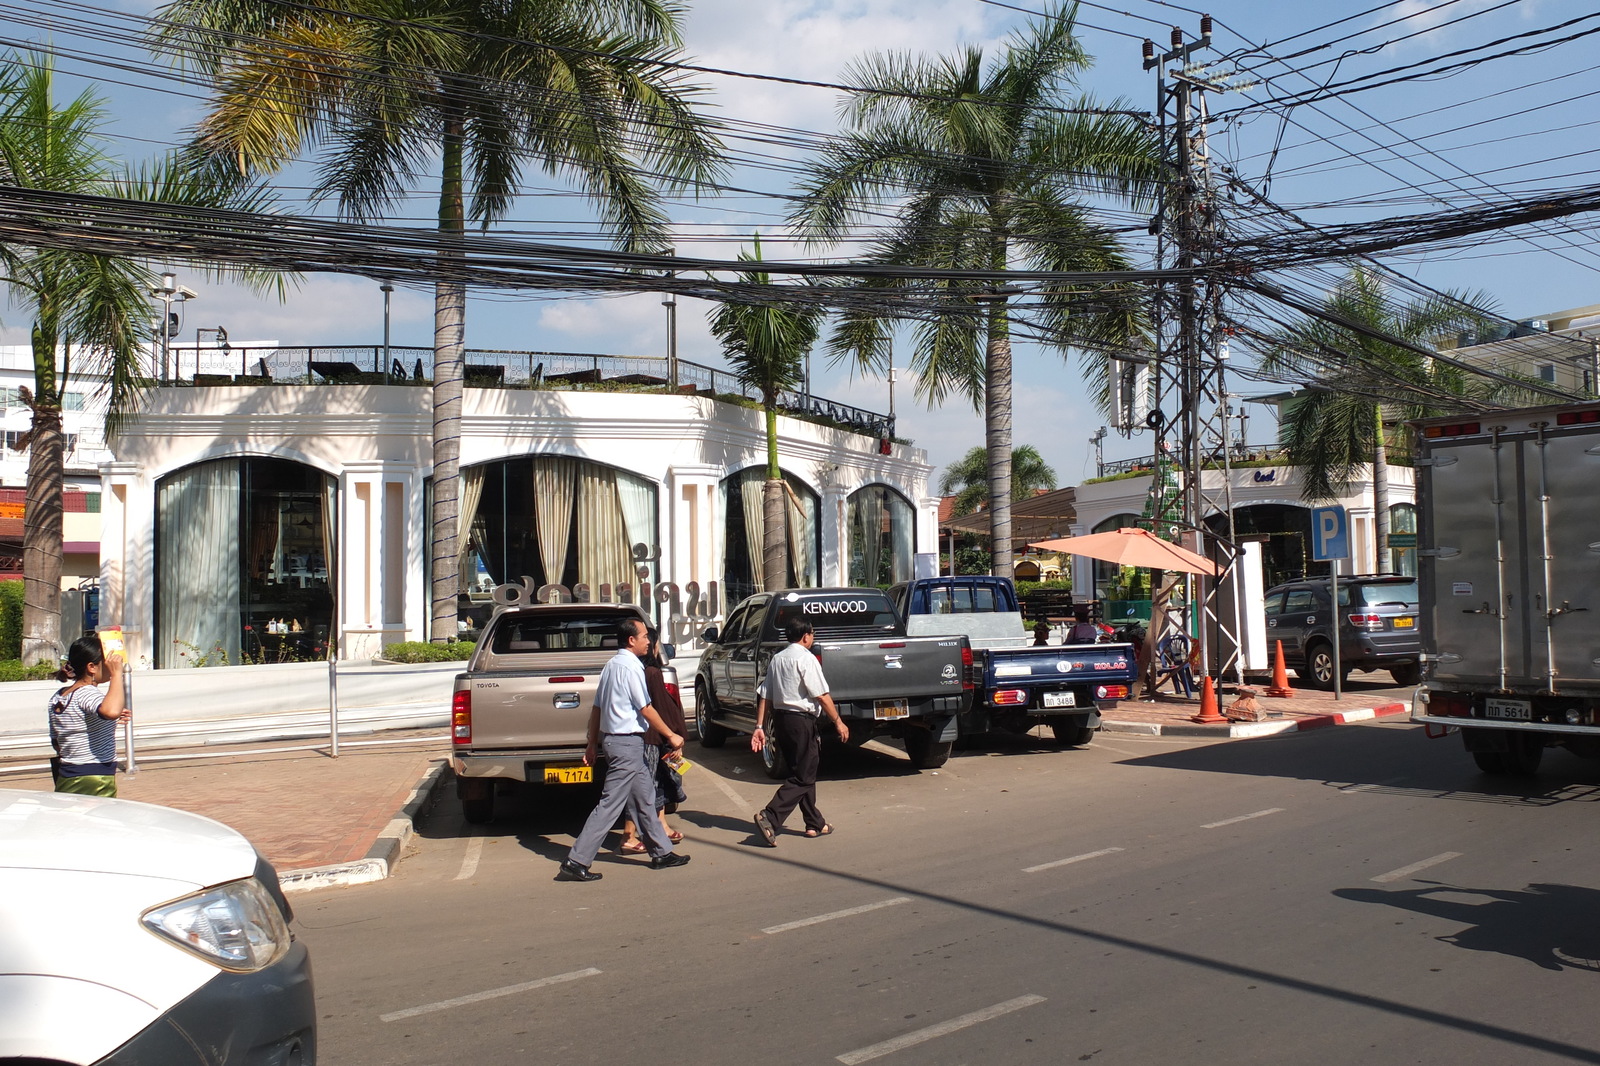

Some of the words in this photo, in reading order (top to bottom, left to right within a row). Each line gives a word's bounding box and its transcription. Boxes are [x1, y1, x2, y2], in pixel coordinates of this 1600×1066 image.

[1320, 510, 1339, 556] P
[802, 600, 868, 614] KENWOOD
[1094, 661, 1127, 670] KOLAO
[1056, 697, 1074, 705] 3488
[1504, 707, 1529, 718] 5614
[565, 771, 589, 782] 7174
